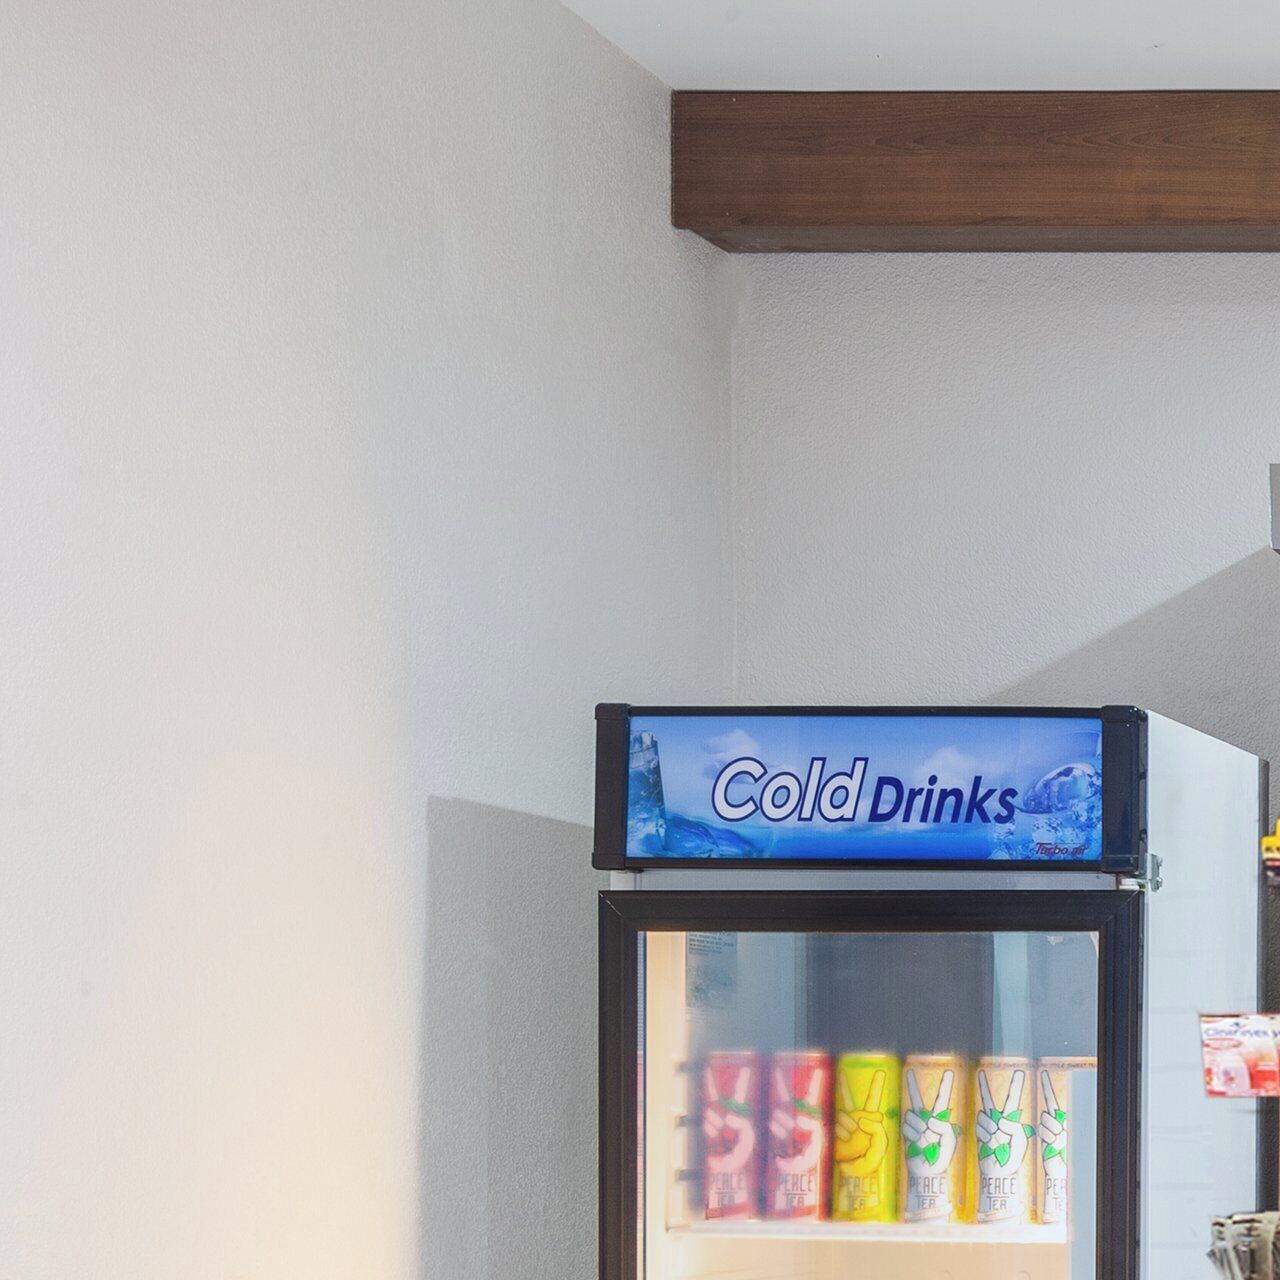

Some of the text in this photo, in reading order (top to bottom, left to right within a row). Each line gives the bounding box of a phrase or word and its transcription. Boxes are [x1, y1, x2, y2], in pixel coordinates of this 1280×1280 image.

[712, 757, 1019, 824] Cold Drinks
[909, 1176, 947, 1196] PEACE
[982, 1176, 1017, 1196] PEACE
